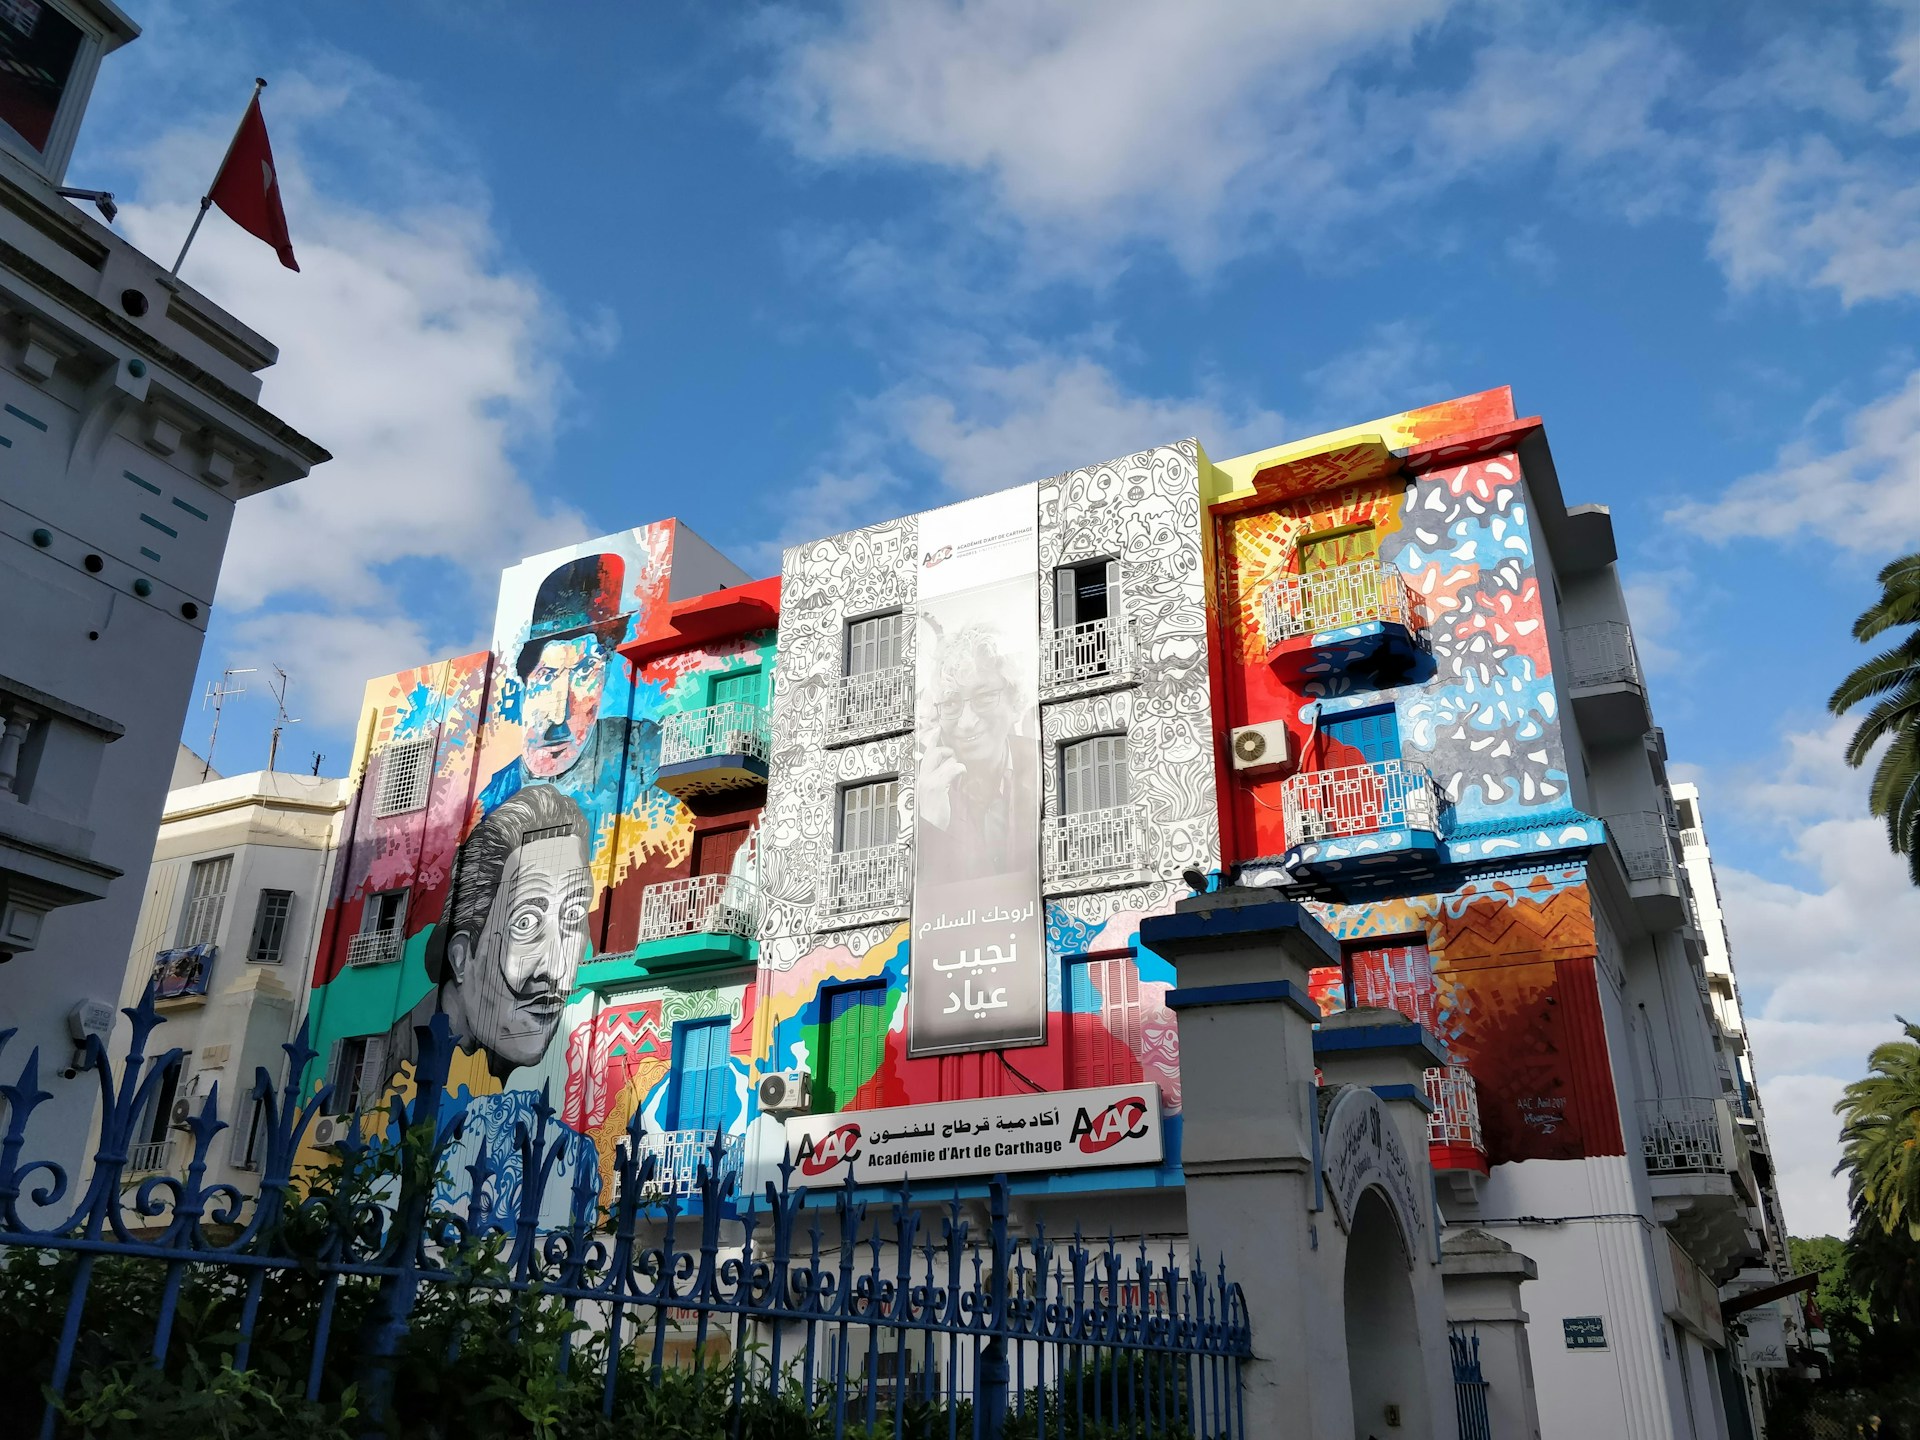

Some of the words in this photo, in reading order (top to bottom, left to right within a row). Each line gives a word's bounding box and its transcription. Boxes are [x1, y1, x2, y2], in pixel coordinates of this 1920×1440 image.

[957, 539, 982, 550] ACADÉMIE
[983, 535, 997, 544] D'ART
[1006, 527, 1033, 538] CARTHAGE
[918, 909, 976, 940] السلام
[981, 901, 1034, 923] لروحك
[932, 933, 1017, 979] نجيب
[943, 979, 1008, 1019] عياد
[942, 1117, 990, 1138] قرطاج
[1068, 1099, 1149, 1148] AAC
[794, 1126, 862, 1172] AAC
[868, 1149, 936, 1167] Académie
[939, 1147, 971, 1161] d'Art
[974, 1144, 991, 1158] de
[995, 1140, 1062, 1157] Carthage
